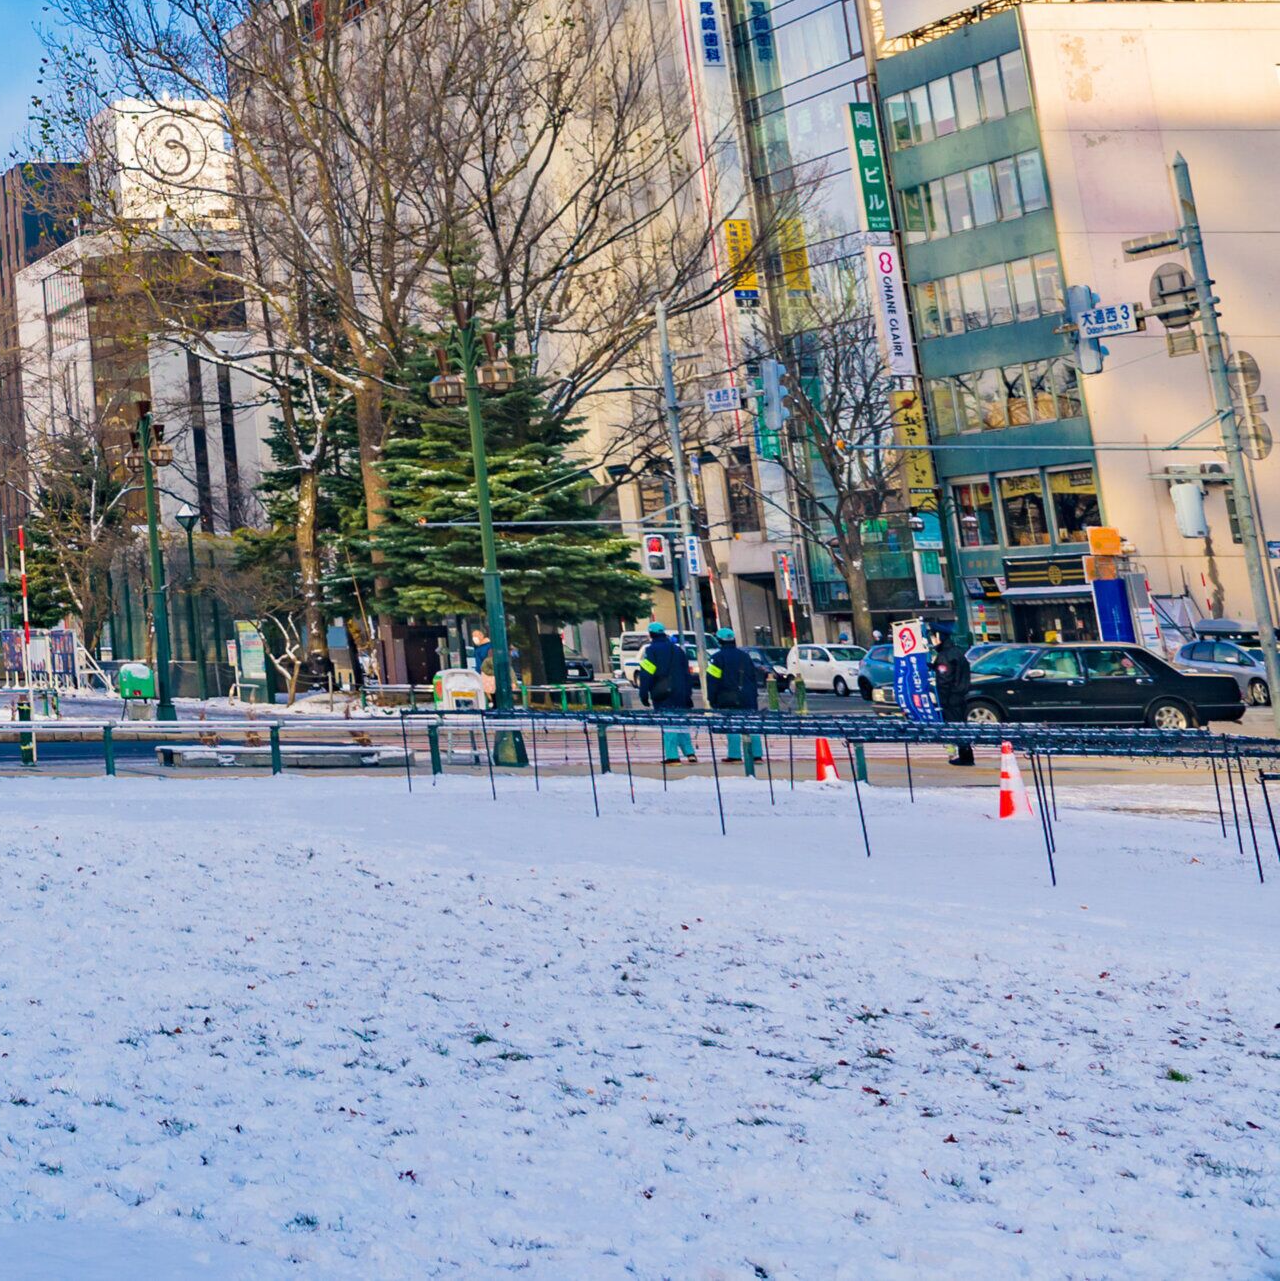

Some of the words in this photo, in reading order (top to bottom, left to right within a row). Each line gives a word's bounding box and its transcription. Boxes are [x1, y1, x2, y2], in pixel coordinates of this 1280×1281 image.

[700, 2, 720, 62] 尾崎歯科
[854, 110, 884, 210] 陶管ビル
[1081, 307, 1117, 326] 大通西
[1120, 305, 1130, 320] 3
[731, 389, 737, 400] 2
